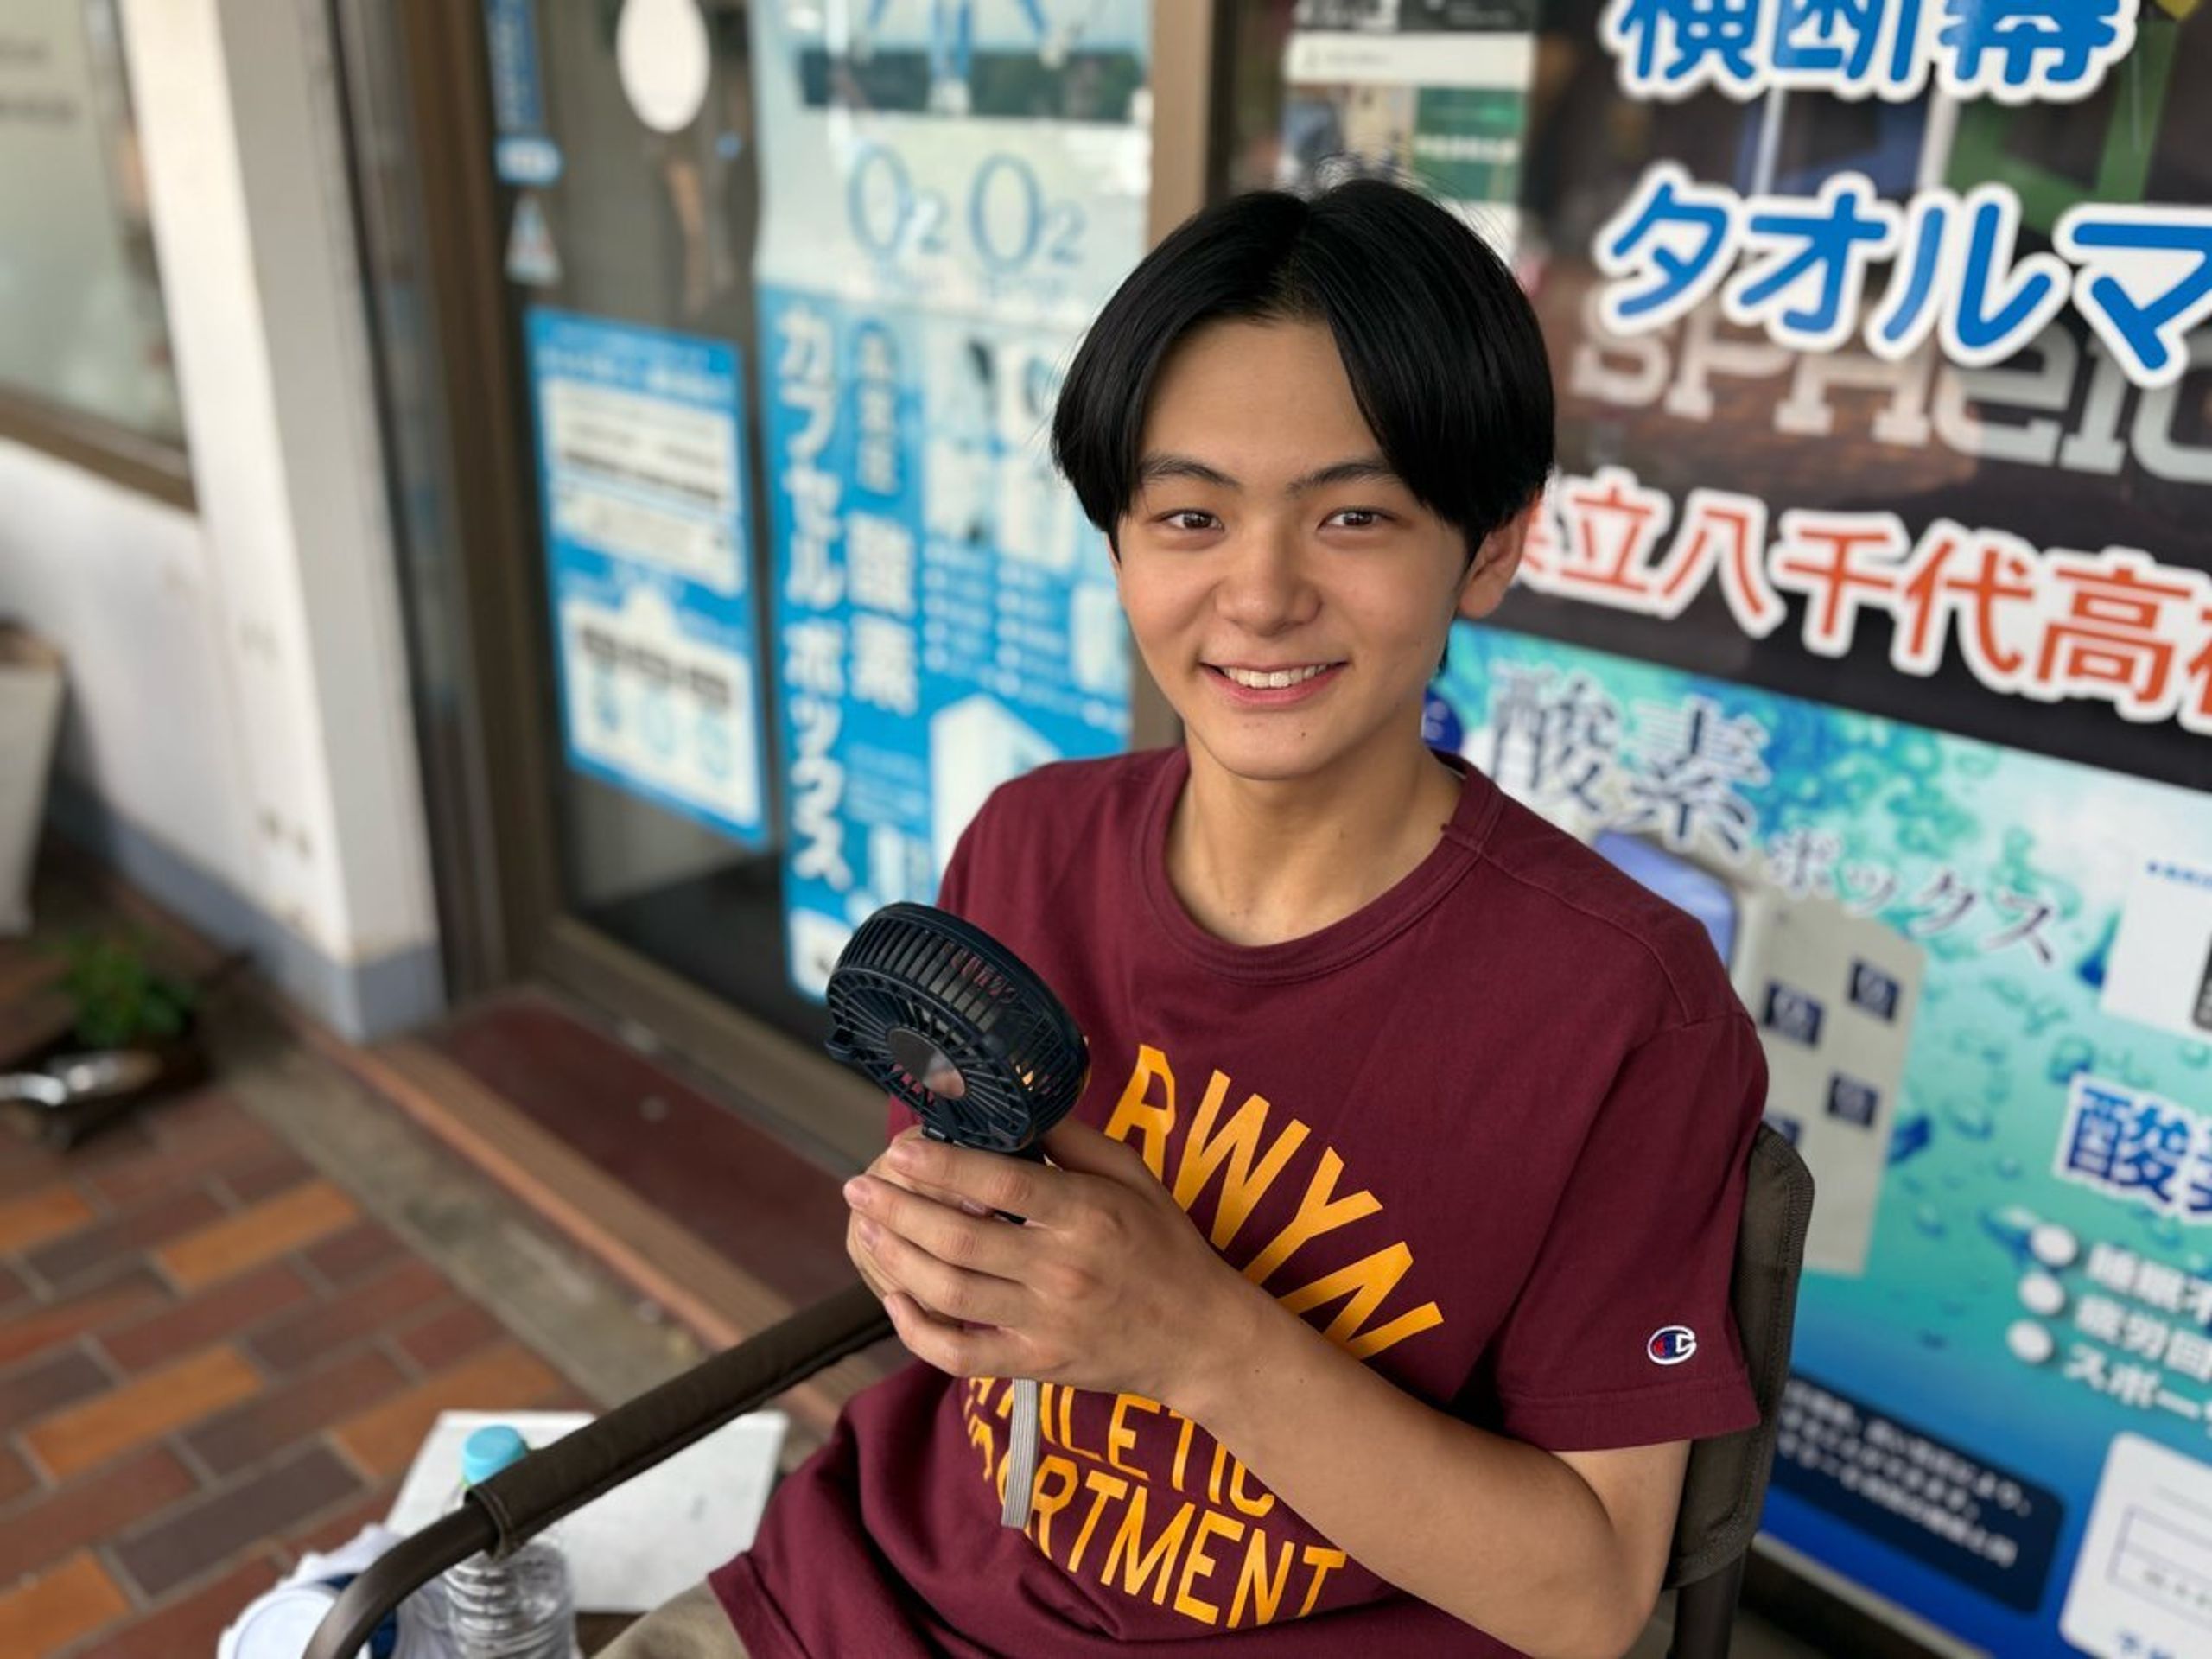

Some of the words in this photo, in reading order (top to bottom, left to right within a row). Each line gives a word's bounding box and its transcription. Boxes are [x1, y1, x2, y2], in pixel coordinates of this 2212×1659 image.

[1609, 0, 2127, 92] 横断幕
[1605, 173, 2212, 378] タオルマ
[1522, 480, 2212, 719] 立八千代高
[1103, 1042, 1445, 1360] RWYN
[2065, 1344, 2212, 1424] スポー
